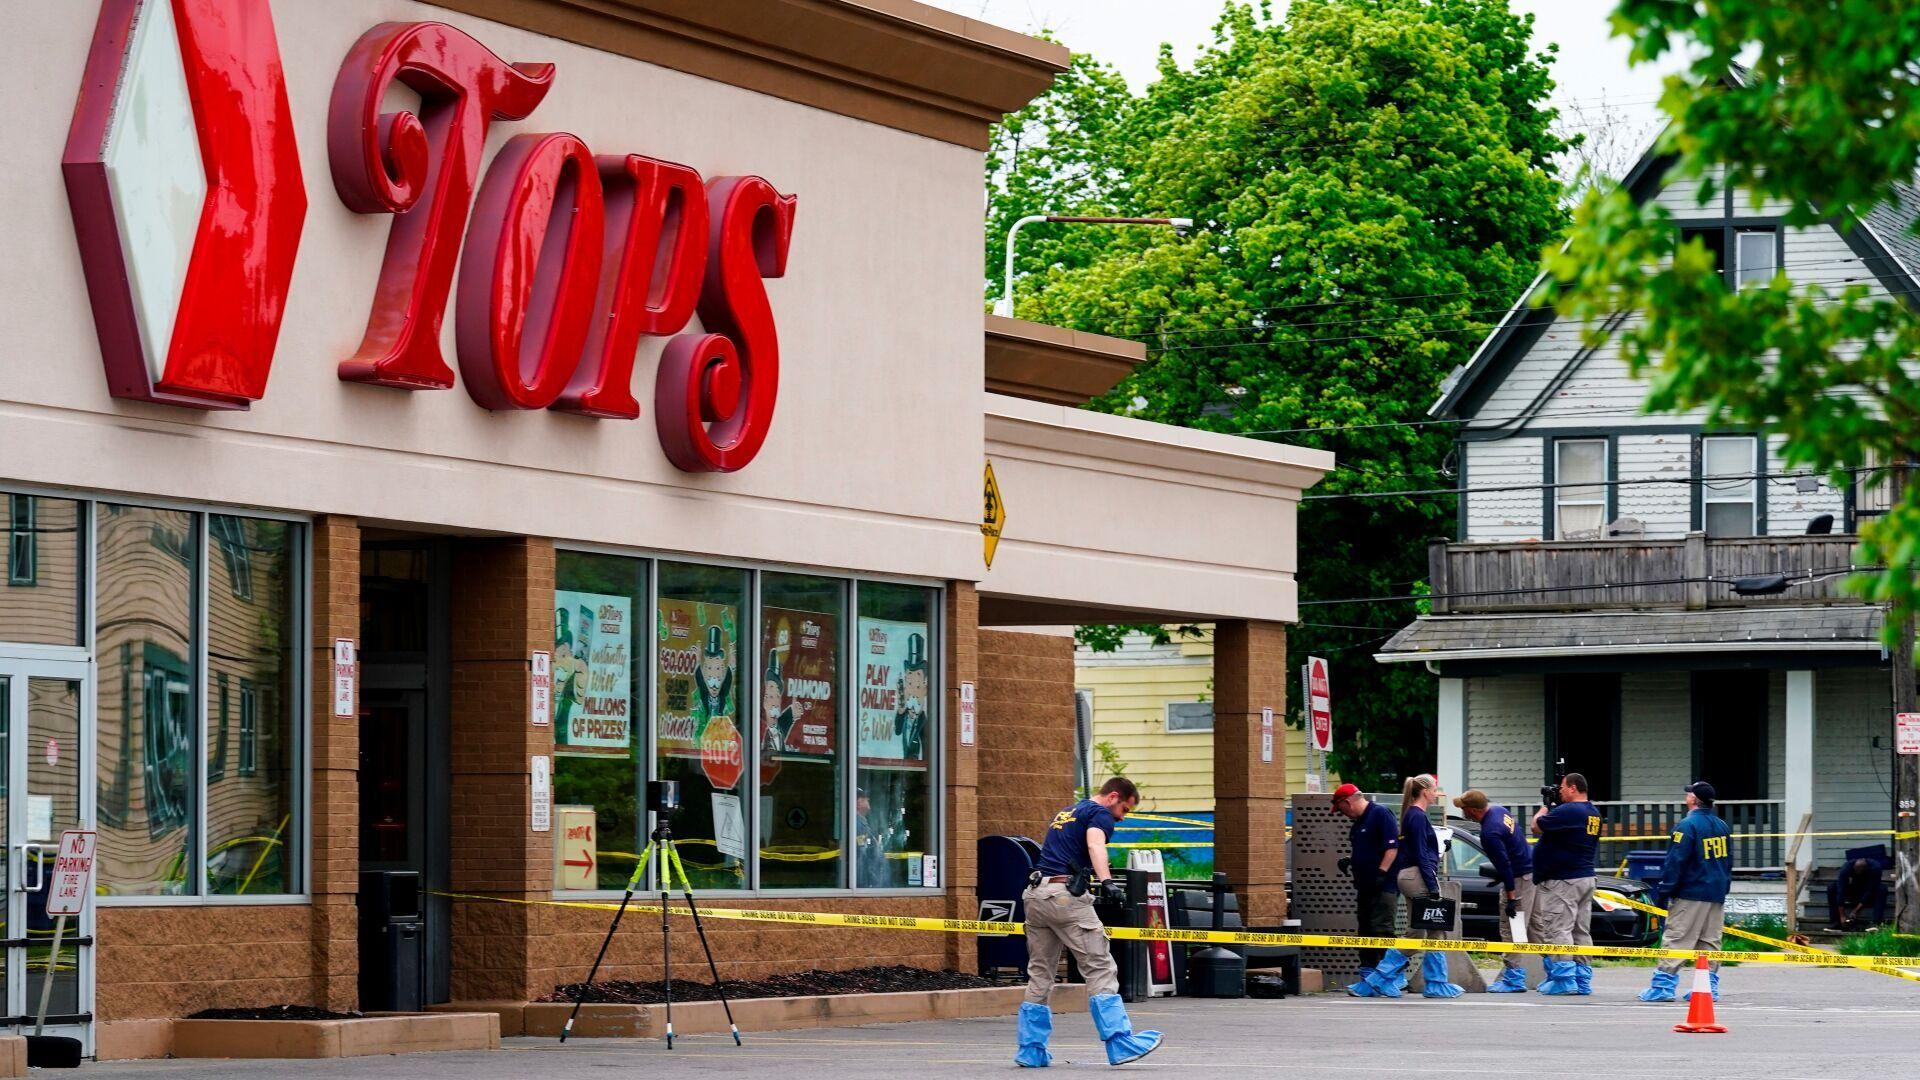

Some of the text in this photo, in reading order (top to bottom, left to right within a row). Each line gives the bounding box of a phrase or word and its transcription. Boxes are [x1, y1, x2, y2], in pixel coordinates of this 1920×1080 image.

[327, 21, 797, 473] TOPS
[866, 663, 890, 686] PLAY
[787, 678, 831, 701] DIAMOND
[583, 697, 627, 717] MILLIONS
[861, 687, 896, 711] ONLINE
[572, 717, 627, 740] OF PRIZES!
[70, 838, 86, 854] NO
[1703, 836, 1727, 859] FBI
[57, 857, 91, 873] PARKING
[63, 874, 79, 884] FIRE
[59, 886, 78, 898] LANE
[944, 920, 1015, 931] CRIME SCENE DO NOT CROSS
[1139, 928, 1208, 940] CRIME SCENE DO NOT CROSS
[1328, 936, 1396, 947] CRIME SCENE DO NOT CROSS
[1420, 940, 1488, 950] CRIME SCENE DO NOT CROSS
[1784, 953, 1849, 964] CRIME SCENE DO NOT CROSS
